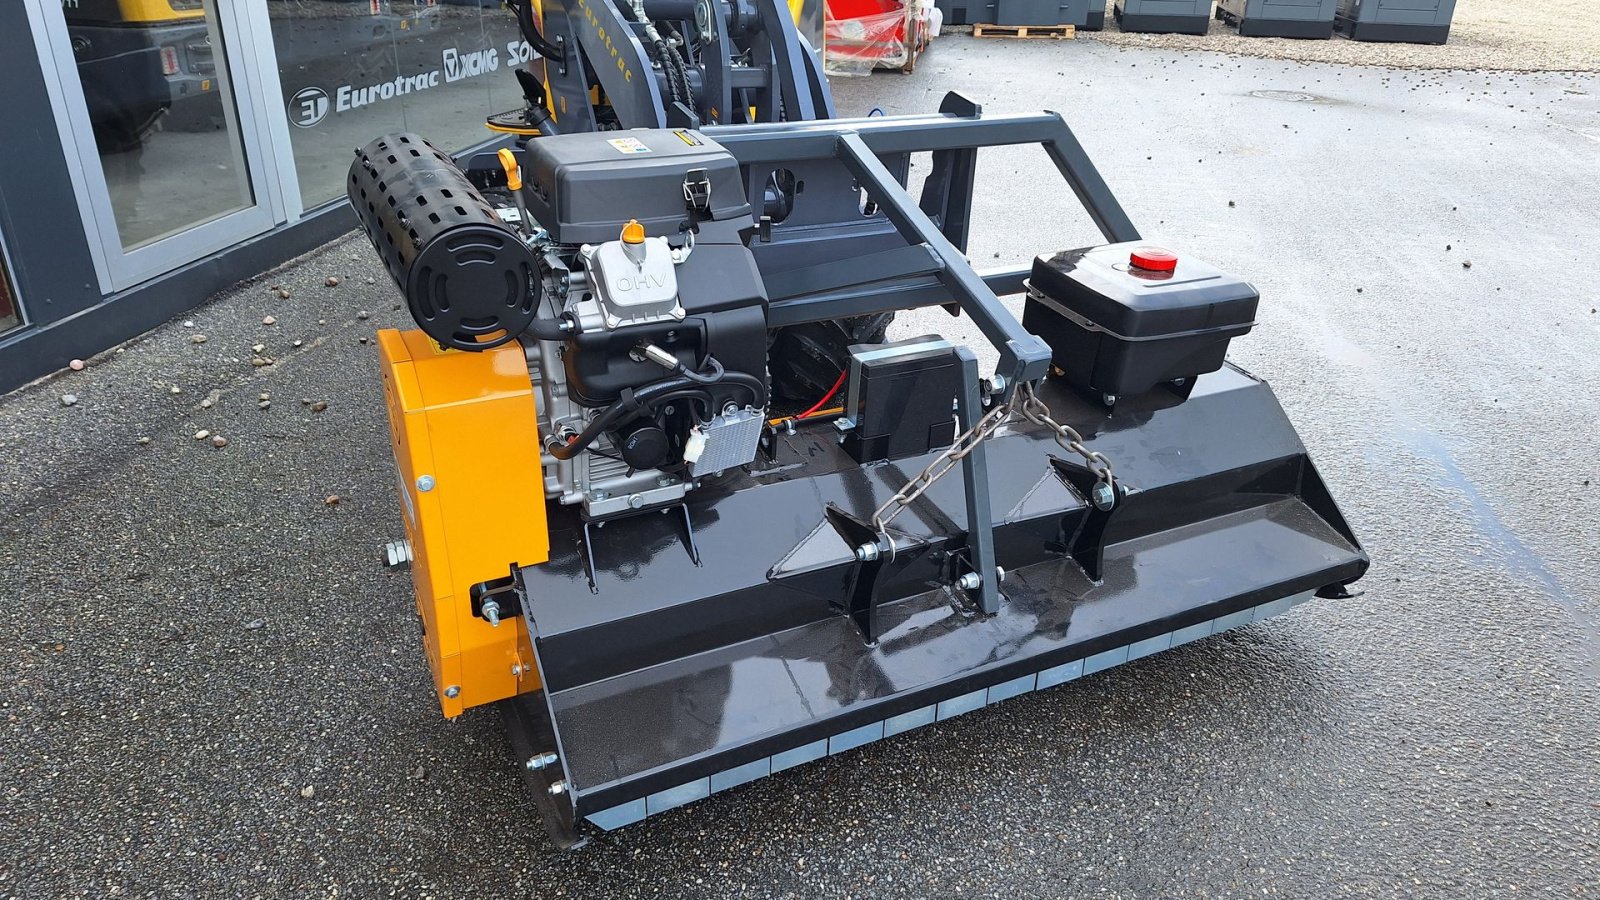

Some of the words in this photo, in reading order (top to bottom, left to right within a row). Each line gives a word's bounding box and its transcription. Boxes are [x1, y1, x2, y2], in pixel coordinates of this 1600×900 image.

[335, 70, 440, 112] Eurotrac
[459, 48, 499, 79] XCMG
[616, 271, 668, 292] OHV
